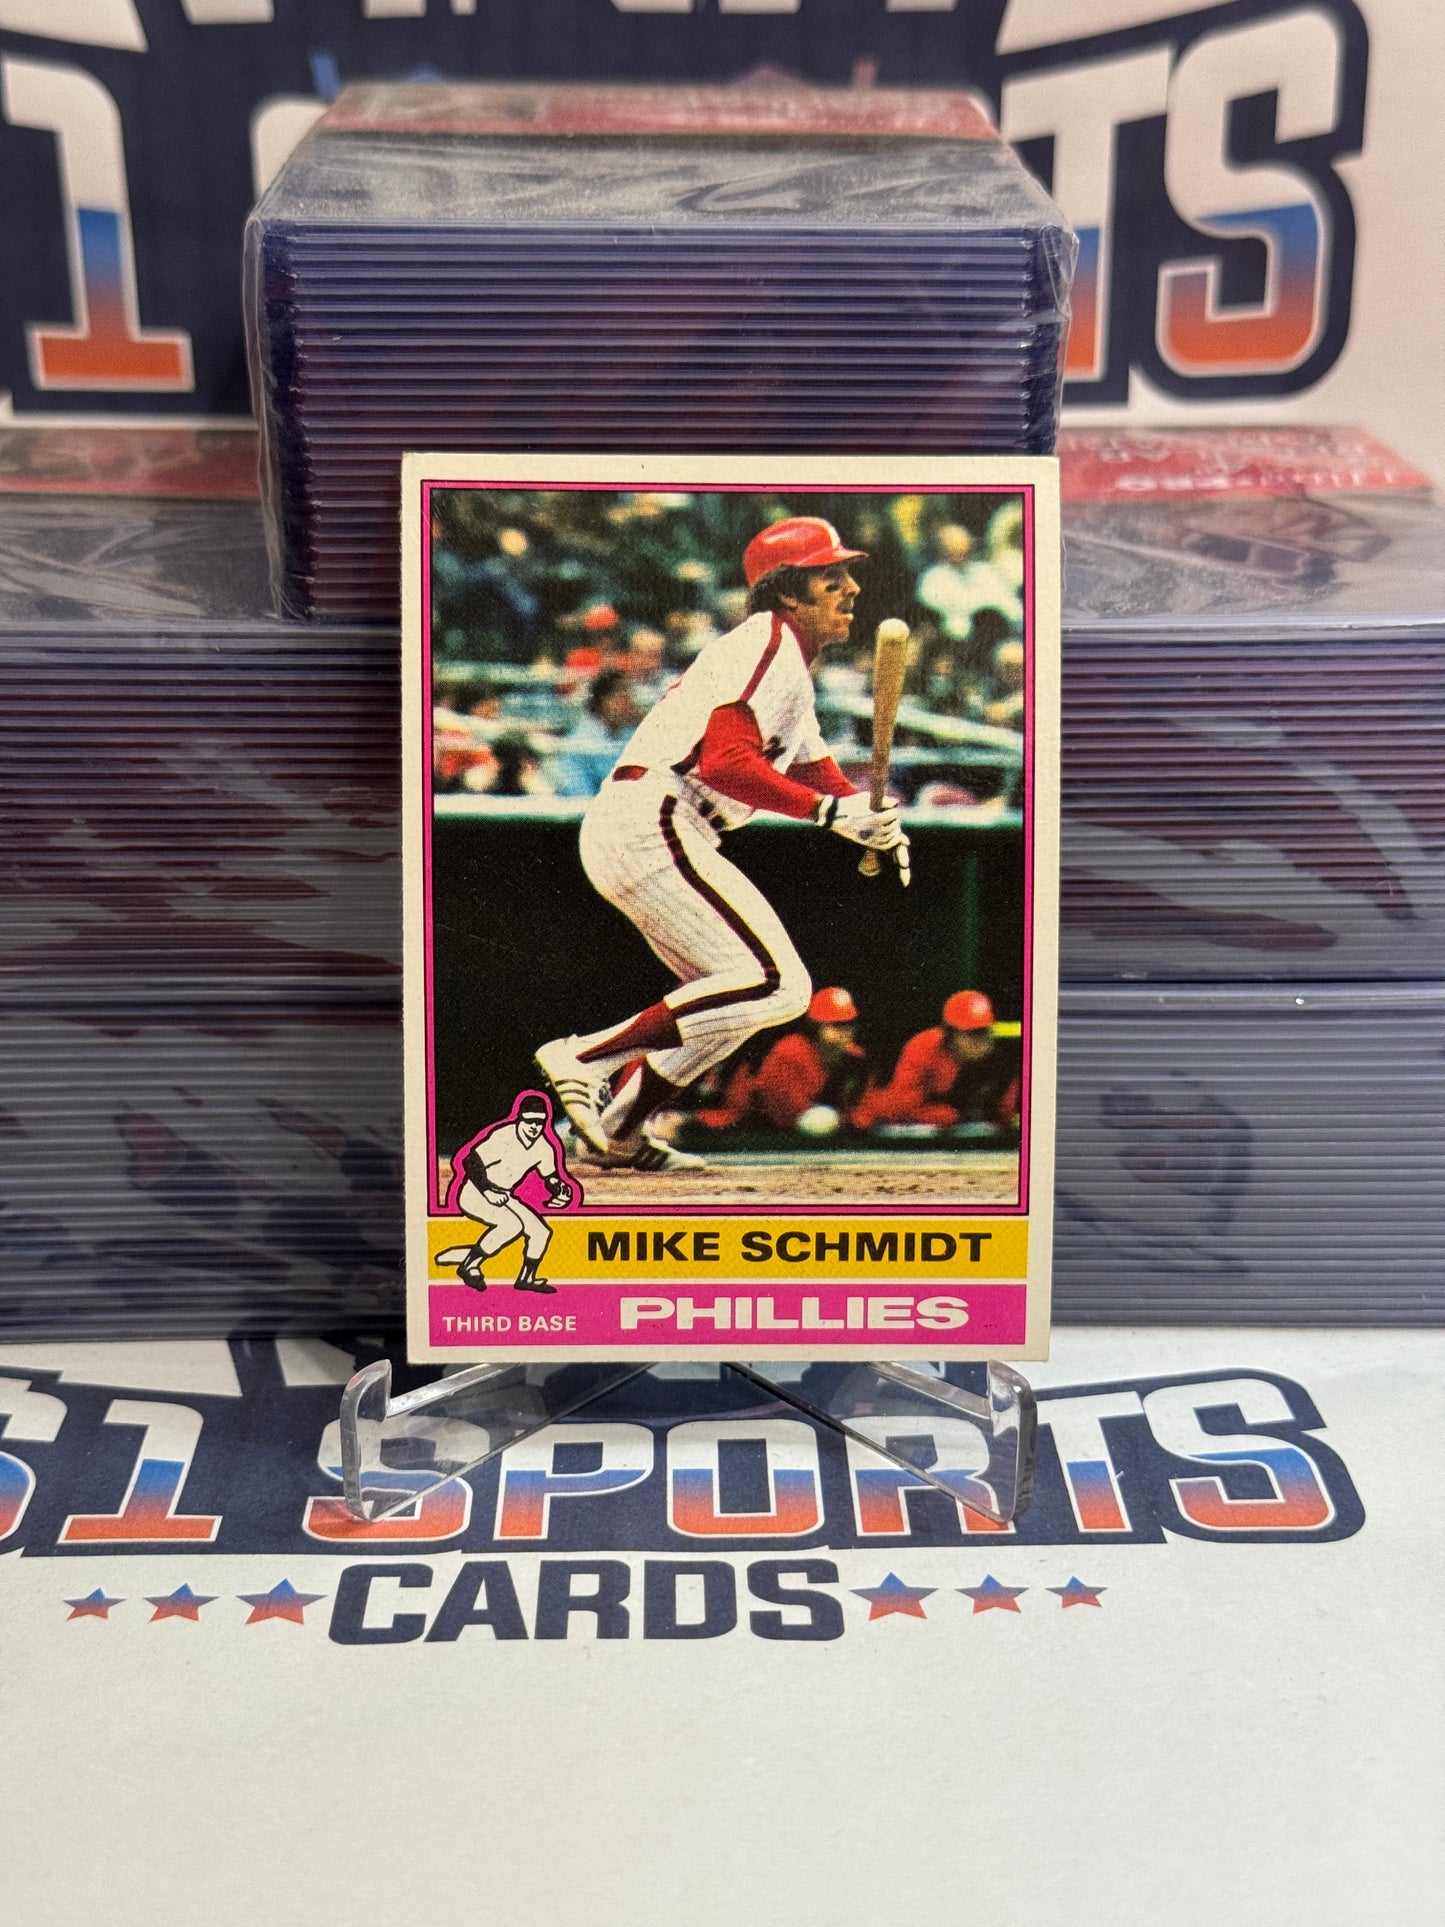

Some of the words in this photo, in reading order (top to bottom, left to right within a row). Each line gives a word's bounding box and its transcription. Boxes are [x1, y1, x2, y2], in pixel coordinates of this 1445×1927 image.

[588, 1231, 721, 1262] MIKE
[741, 1231, 993, 1263] SCHMIDT
[442, 1315, 512, 1332] THIRD
[517, 1315, 577, 1332] BASE
[620, 1295, 970, 1331] PHILLIES
[302, 1376, 1336, 1543] SPORTS
[328, 1557, 845, 1645] CARDS
